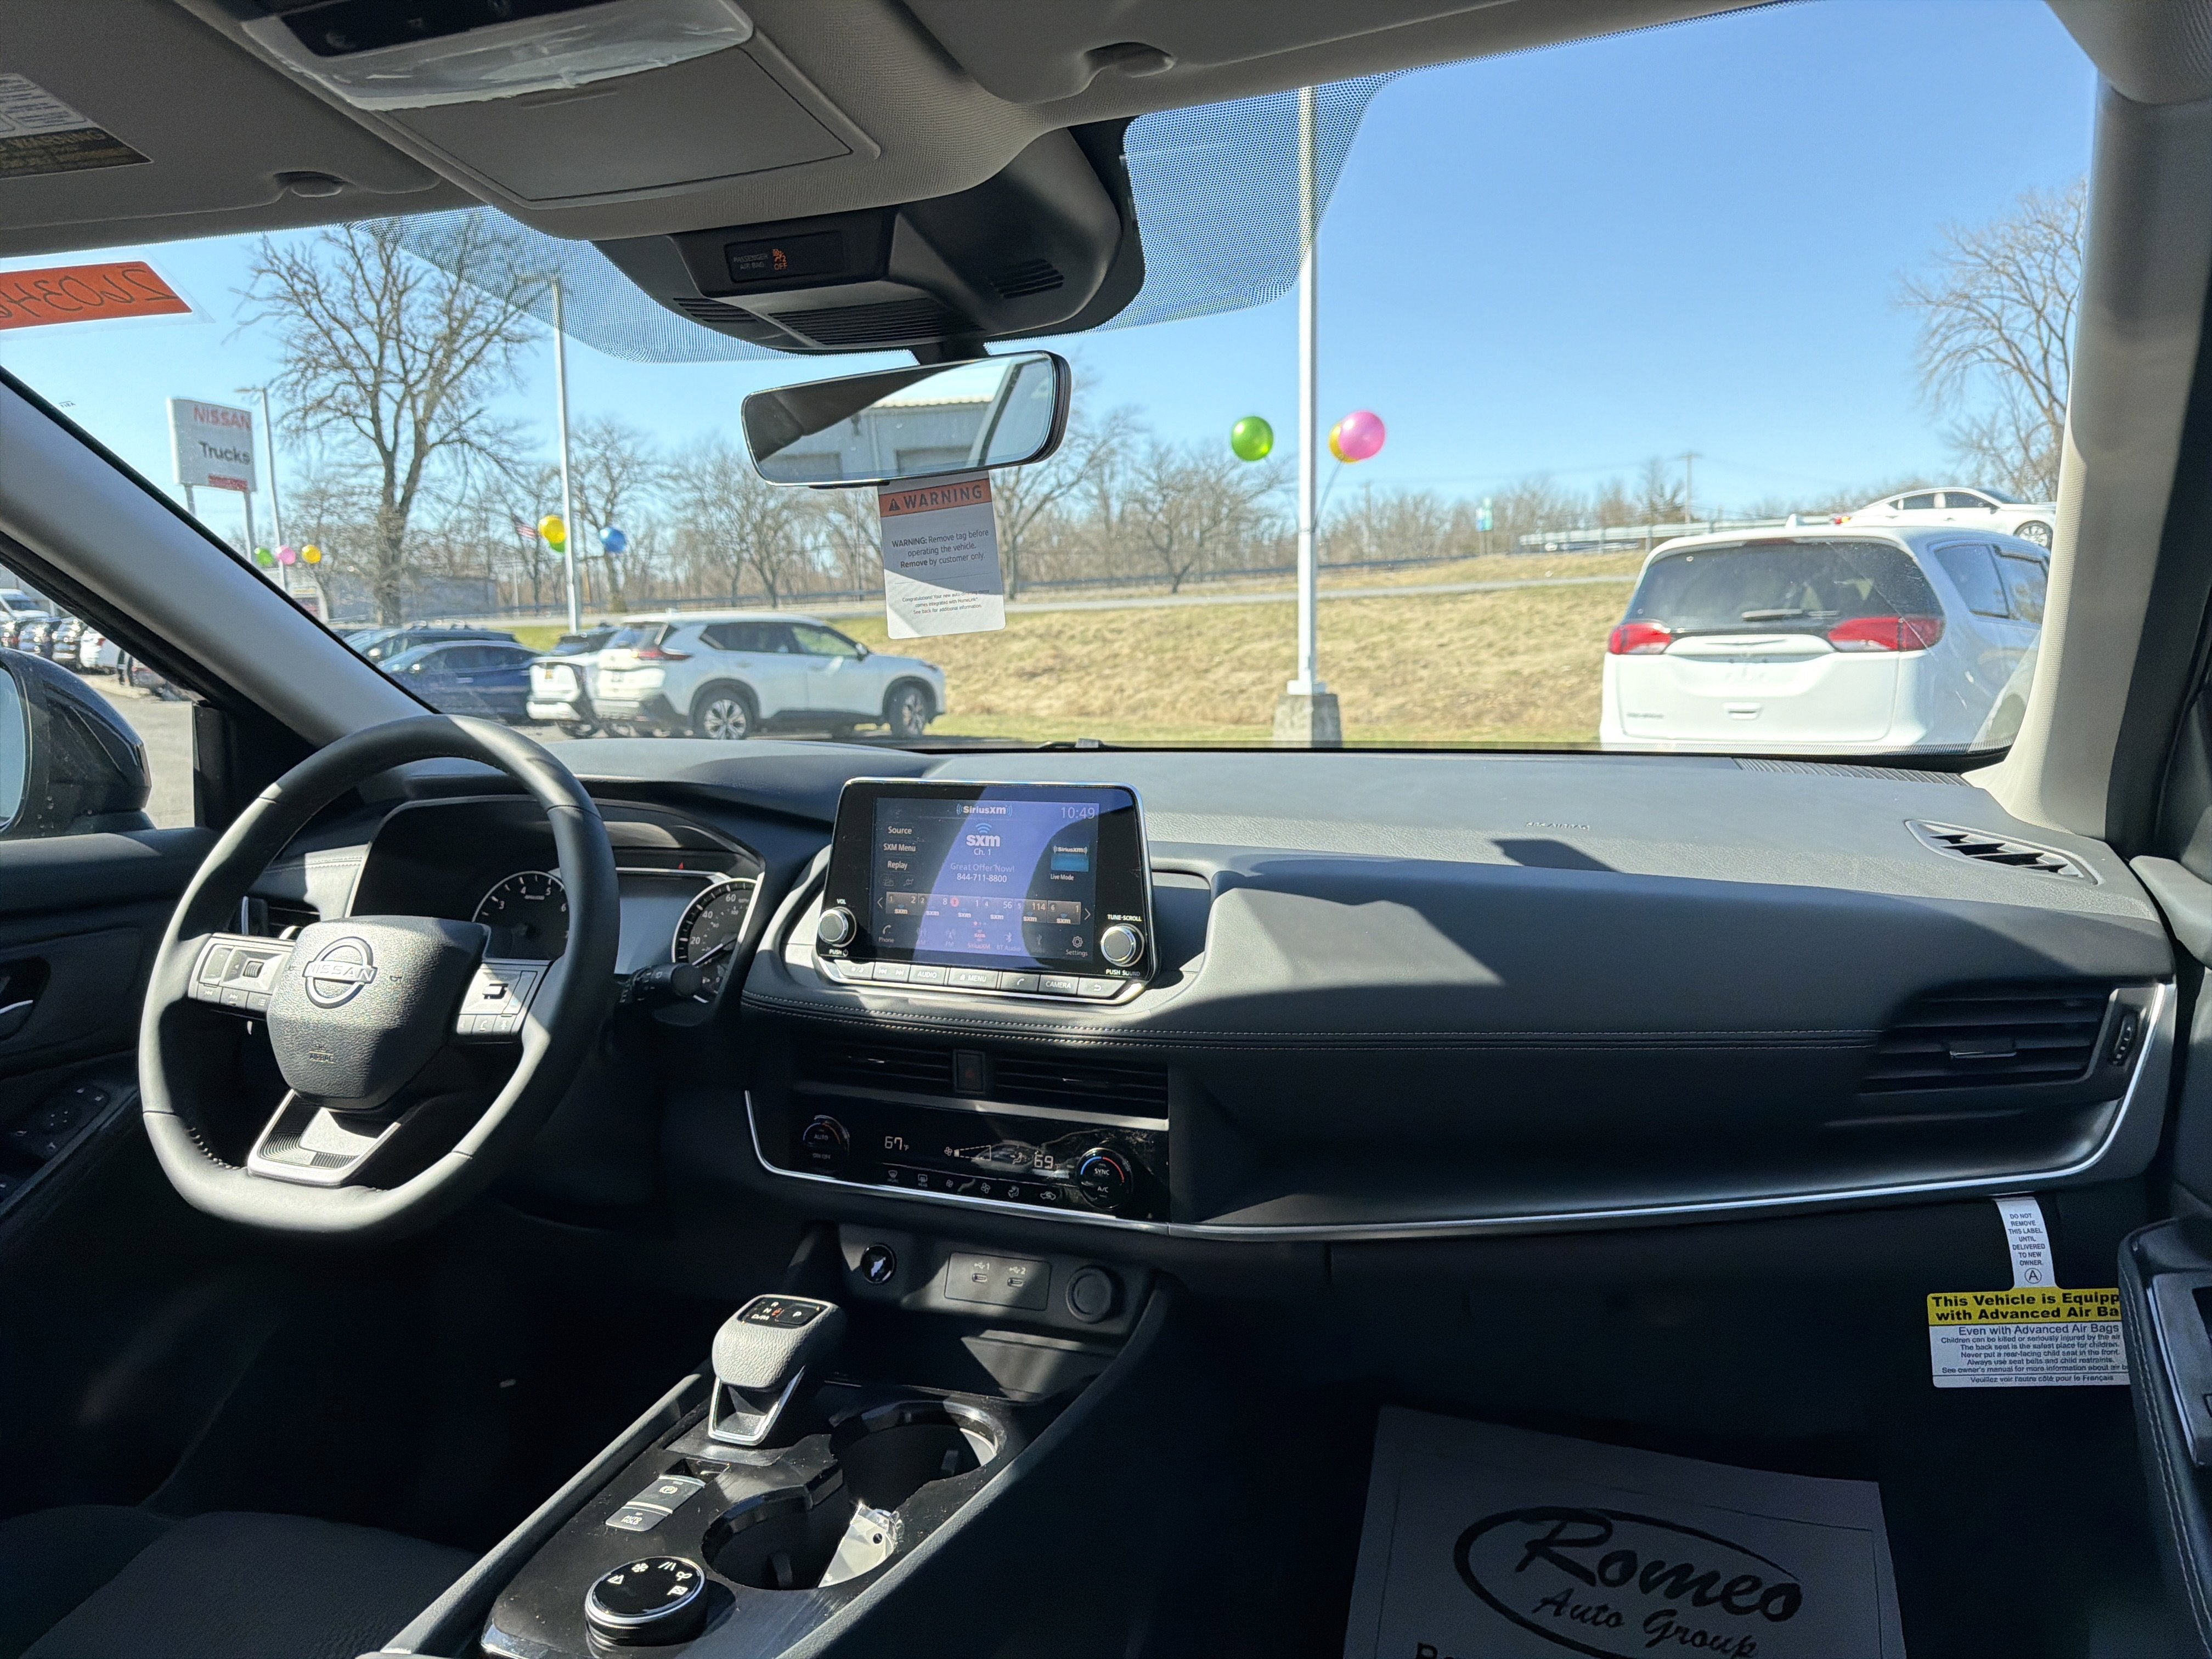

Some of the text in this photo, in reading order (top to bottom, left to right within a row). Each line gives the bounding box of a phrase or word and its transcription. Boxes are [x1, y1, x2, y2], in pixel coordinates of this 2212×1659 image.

[733, 253, 768, 262] PASSENGER
[774, 262, 788, 270] OFF
[194, 405, 251, 431] NISSAN
[198, 440, 250, 465] Trucks
[904, 485, 981, 509] WARNING
[891, 529, 989, 548] WARNING: Remove tag before
[907, 548, 939, 557] operating
[953, 542, 977, 551] vehicle.
[900, 552, 985, 568] Remove by customer only.
[1061, 806, 1096, 819] 10:49
[888, 826, 912, 834] Source
[967, 834, 1001, 847] sxm
[883, 843, 898, 851] SXM
[888, 860, 908, 871] Replay
[951, 862, 970, 871] Great
[957, 873, 1007, 882] 844-711-8800
[520, 886, 527, 894] 4
[545, 887, 551, 895] 5
[725, 894, 736, 902] 60
[499, 900, 505, 910] 3
[561, 903, 567, 912] 6
[1032, 902, 1046, 911] 114
[702, 911, 713, 919] 40
[690, 936, 701, 944] 20
[307, 963, 375, 981] NISSAN
[1045, 980, 1071, 989] CAMERA
[1094, 1167, 1109, 1176] SYNC
[2028, 1269, 2039, 1281] A
[1932, 1295, 1968, 1307] This
[1973, 1294, 2036, 1306] Vehicle
[2041, 1293, 2056, 1304] is
[1936, 1310, 1972, 1321] with
[1978, 1307, 2061, 1319] Advanced
[2067, 1306, 2091, 1317] Air
[1959, 1323, 2119, 1336] Even with Advanced Air Bags
[1515, 1507, 1804, 1622] Romeo
[1532, 1589, 1757, 1658] Auto Group
